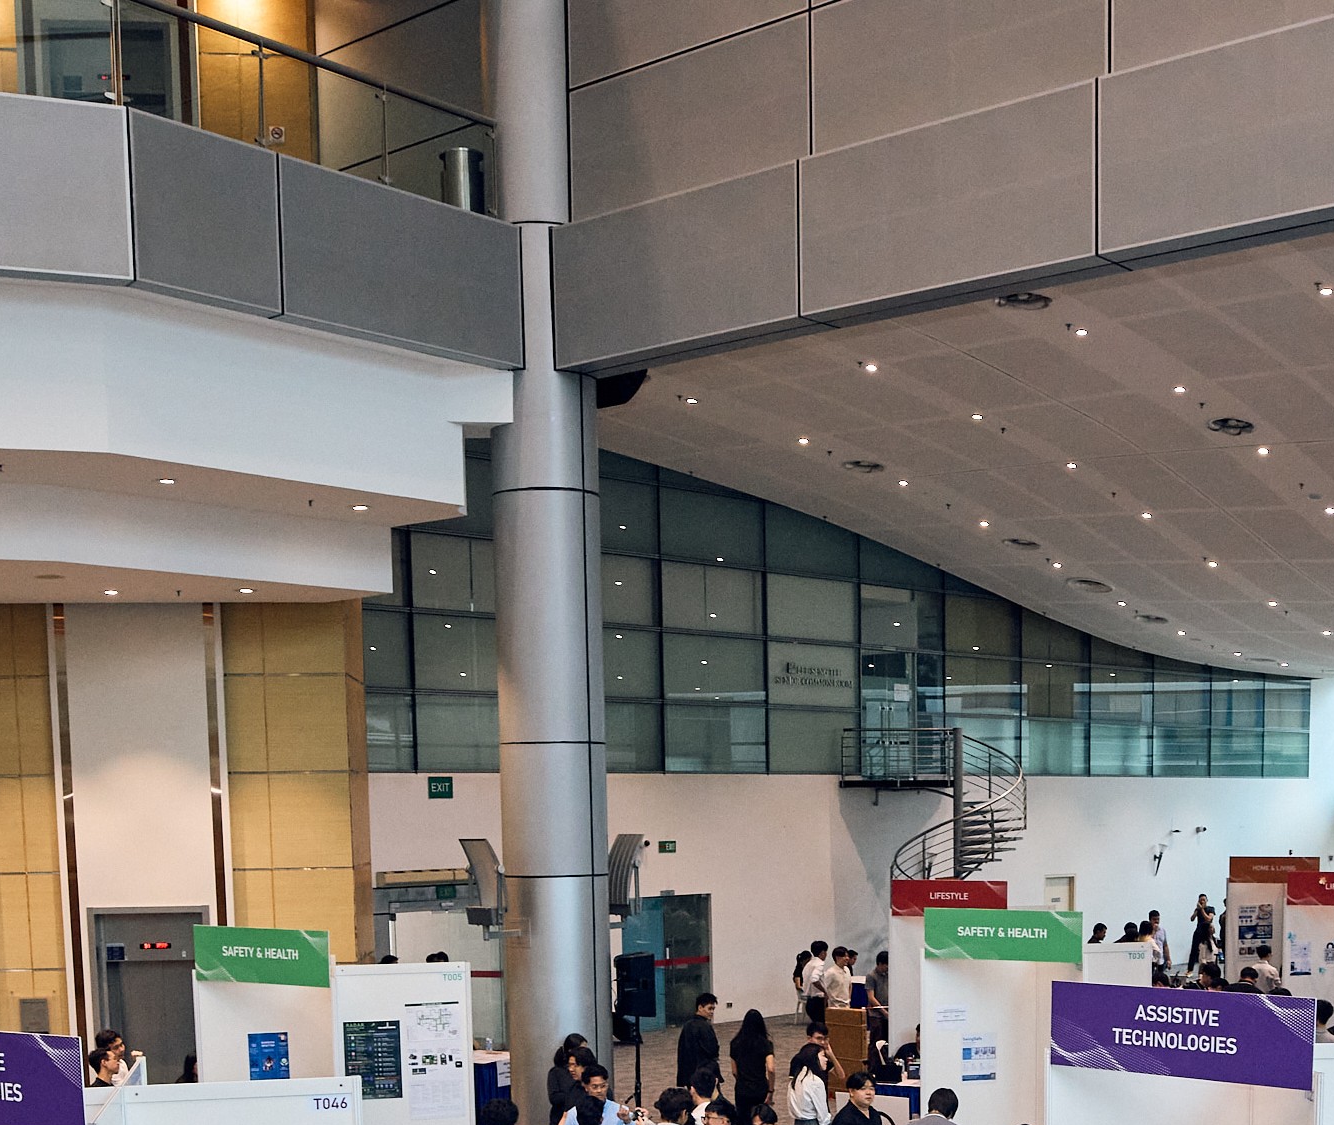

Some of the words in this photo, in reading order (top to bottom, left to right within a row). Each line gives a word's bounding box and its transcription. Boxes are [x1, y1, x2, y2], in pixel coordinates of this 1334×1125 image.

[431, 783, 450, 792] EXIT
[929, 891, 969, 901] LIFESTYLE
[957, 926, 995, 937] SAFETY
[997, 927, 1006, 937] &
[1008, 927, 1048, 938] HEALTH
[222, 946, 254, 957] SAFETY
[256, 947, 263, 958] &
[265, 948, 299, 960] HEALTH
[443, 973, 463, 981] T005
[1134, 1003, 1220, 1028] ASSISTIVE
[1112, 1028, 1238, 1056] TECHNOLOGIES
[313, 1097, 348, 1110] T046
